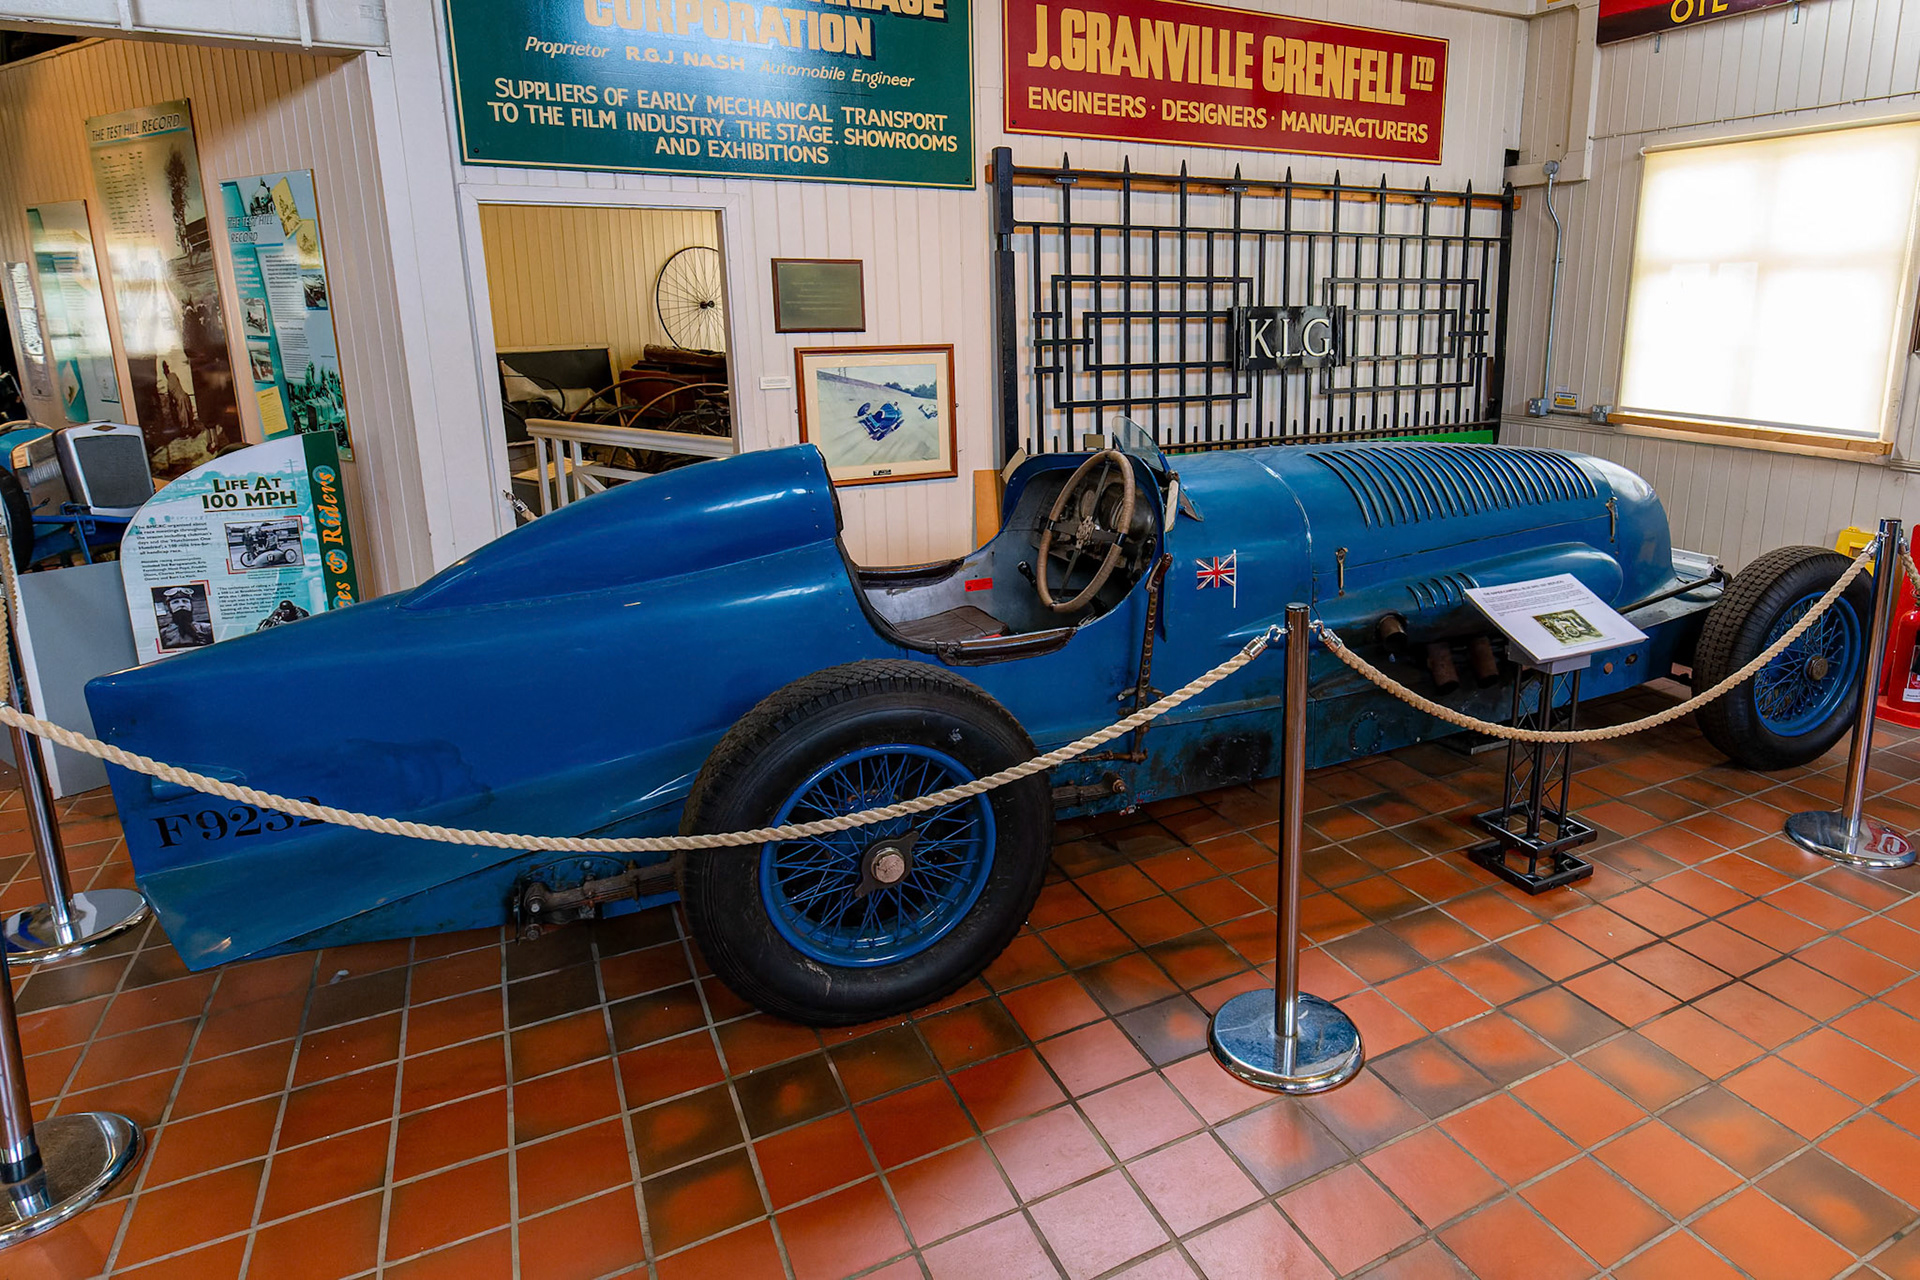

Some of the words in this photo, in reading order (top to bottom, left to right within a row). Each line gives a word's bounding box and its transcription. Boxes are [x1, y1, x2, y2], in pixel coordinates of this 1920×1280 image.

[584, 0, 872, 56] CORPORATION
[1670, 0, 1729, 23] OIL
[525, 36, 610, 58] Proprietor
[625, 46, 678, 65] R.G.J.
[683, 52, 745, 71] NASH
[760, 60, 846, 81] Automobile
[851, 68, 915, 89] Engineer
[1027, 3, 1254, 90] J.GRANVILLE
[1262, 35, 1406, 106] GRENFELL
[1410, 55, 1436, 92] LTD
[494, 77, 598, 105] SUPPLIERS
[603, 87, 629, 107] OF
[637, 89, 698, 112] EARLY
[706, 95, 833, 123] MECHANICAL
[841, 106, 948, 131] TRANSPORT
[1028, 86, 1147, 119] ENGINEERS
[1162, 98, 1268, 129] DESIGNERS
[1281, 109, 1429, 144] MANUFACTURERS
[92, 129, 105, 141] THE
[106, 125, 122, 139] TEST
[124, 121, 139, 135] HILL
[142, 114, 180, 133] RECORD
[487, 101, 519, 124] TO
[523, 104, 565, 126] THE
[571, 108, 617, 130] FILM
[626, 111, 731, 138] INDUSTRY.
[736, 120, 772, 140] THE
[776, 123, 839, 146] STAGE.
[844, 128, 958, 153] SHOWROOMS
[655, 137, 701, 156] AND
[707, 140, 829, 165] EXHIBITIONS
[227, 216, 241, 229] THE
[258, 213, 274, 225] HILL
[230, 232, 259, 243] RECORD
[1248, 318, 1335, 359] K.L.G.
[202, 493, 238, 509] 100
[245, 490, 298, 507] MPH
[212, 478, 249, 493] LIFE
[254, 476, 282, 491] AT
[317, 472, 345, 546] Riders
